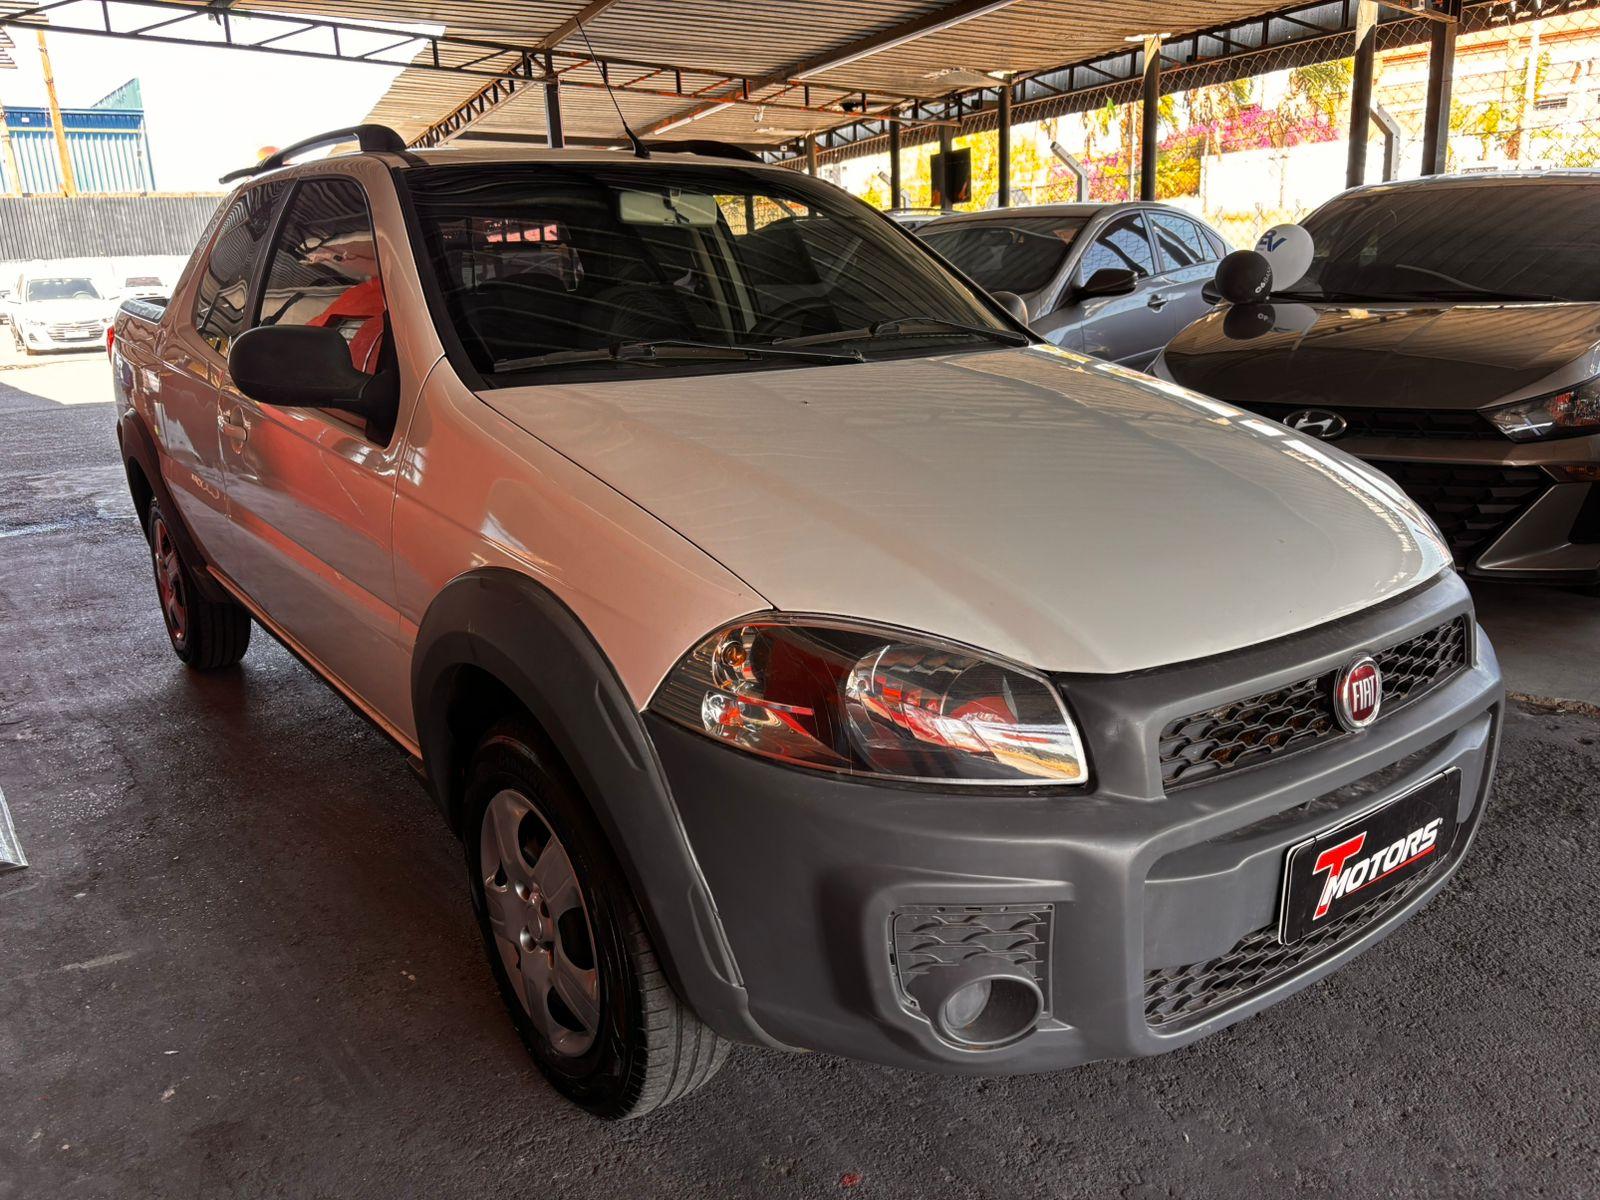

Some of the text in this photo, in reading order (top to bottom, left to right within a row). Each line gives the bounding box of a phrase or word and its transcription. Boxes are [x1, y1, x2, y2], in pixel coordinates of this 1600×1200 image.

[1352, 675, 1375, 713] FIAT
[1312, 817, 1441, 921] T MOTORS
